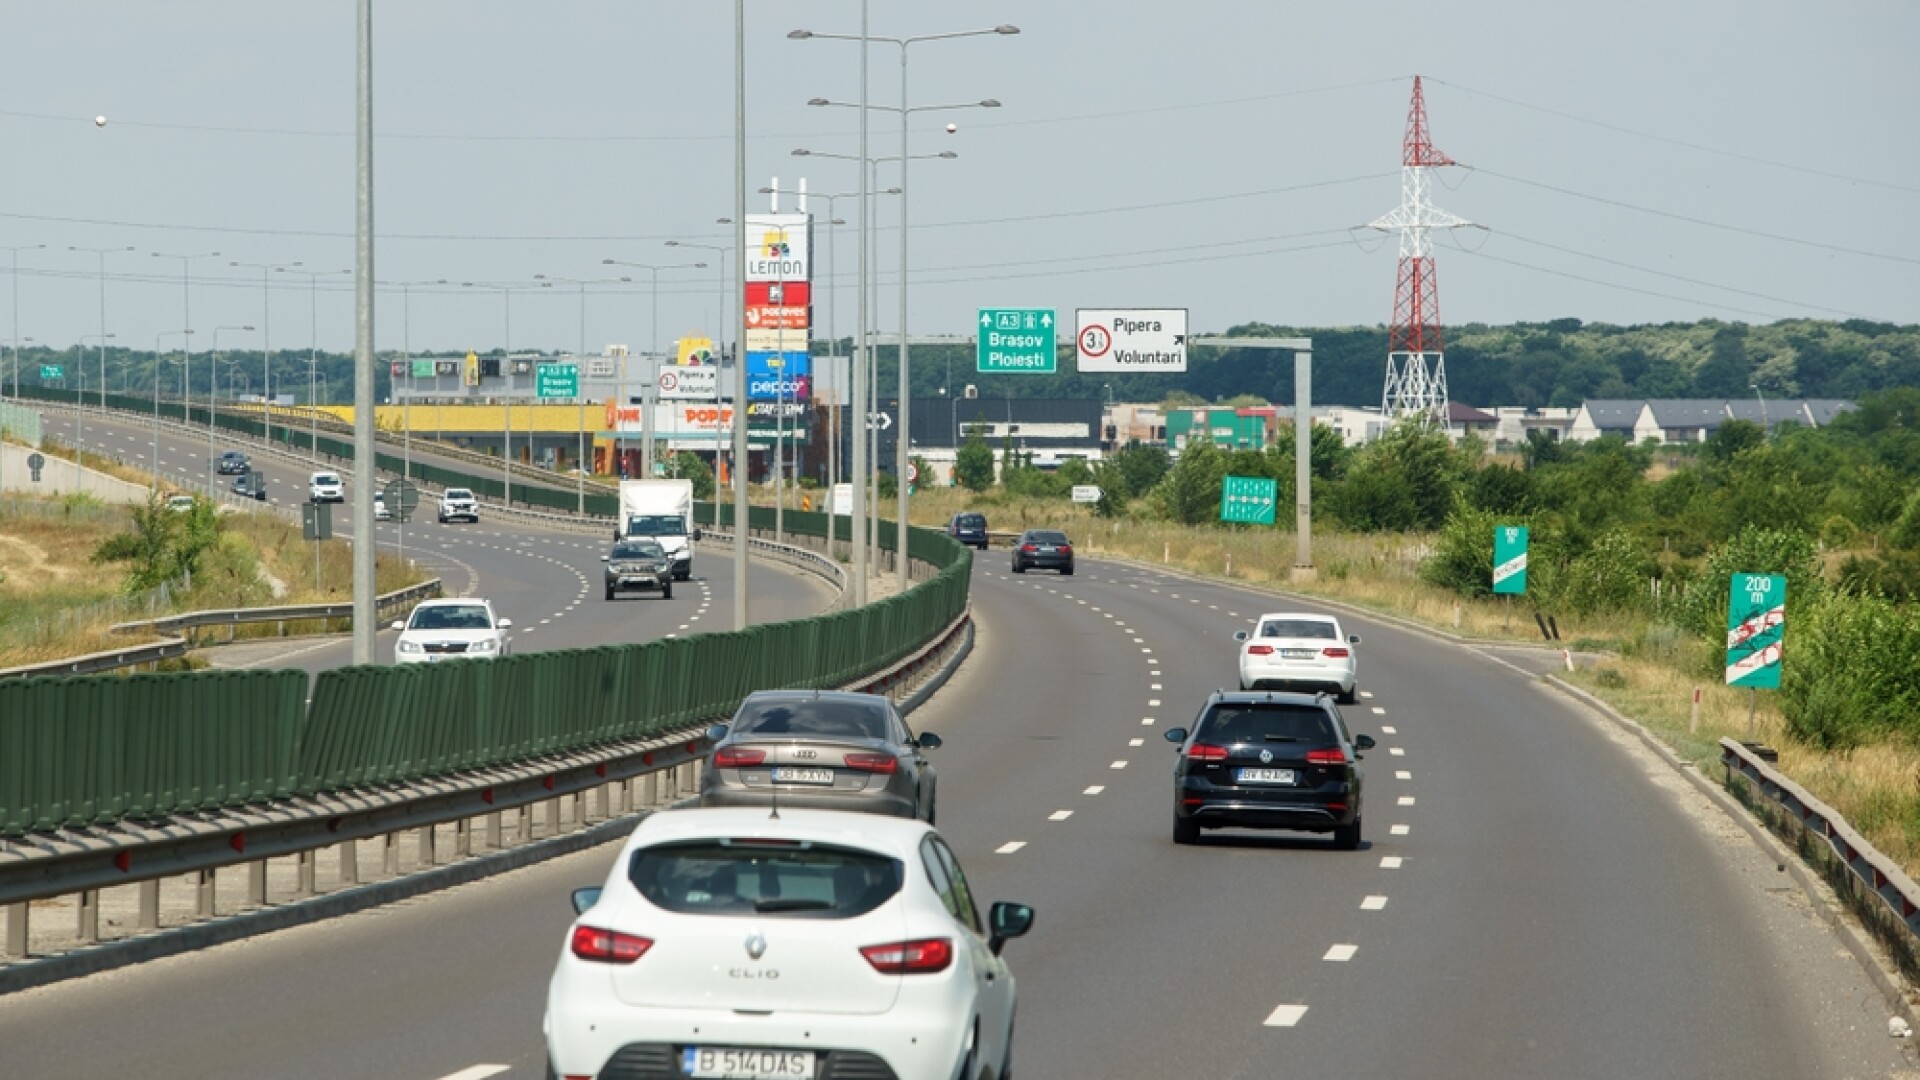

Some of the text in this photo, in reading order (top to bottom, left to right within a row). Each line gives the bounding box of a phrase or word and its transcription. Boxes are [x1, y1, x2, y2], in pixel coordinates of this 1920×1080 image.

[1001, 315, 1018, 327] A3
[1113, 317, 1162, 336] Pipera
[1113, 350, 1182, 364] Voluntari
[1745, 576, 1771, 592] 200
[1751, 592, 1763, 604] m
[728, 967, 780, 979] CLIO
[700, 1050, 806, 1075] B 514 DAS
